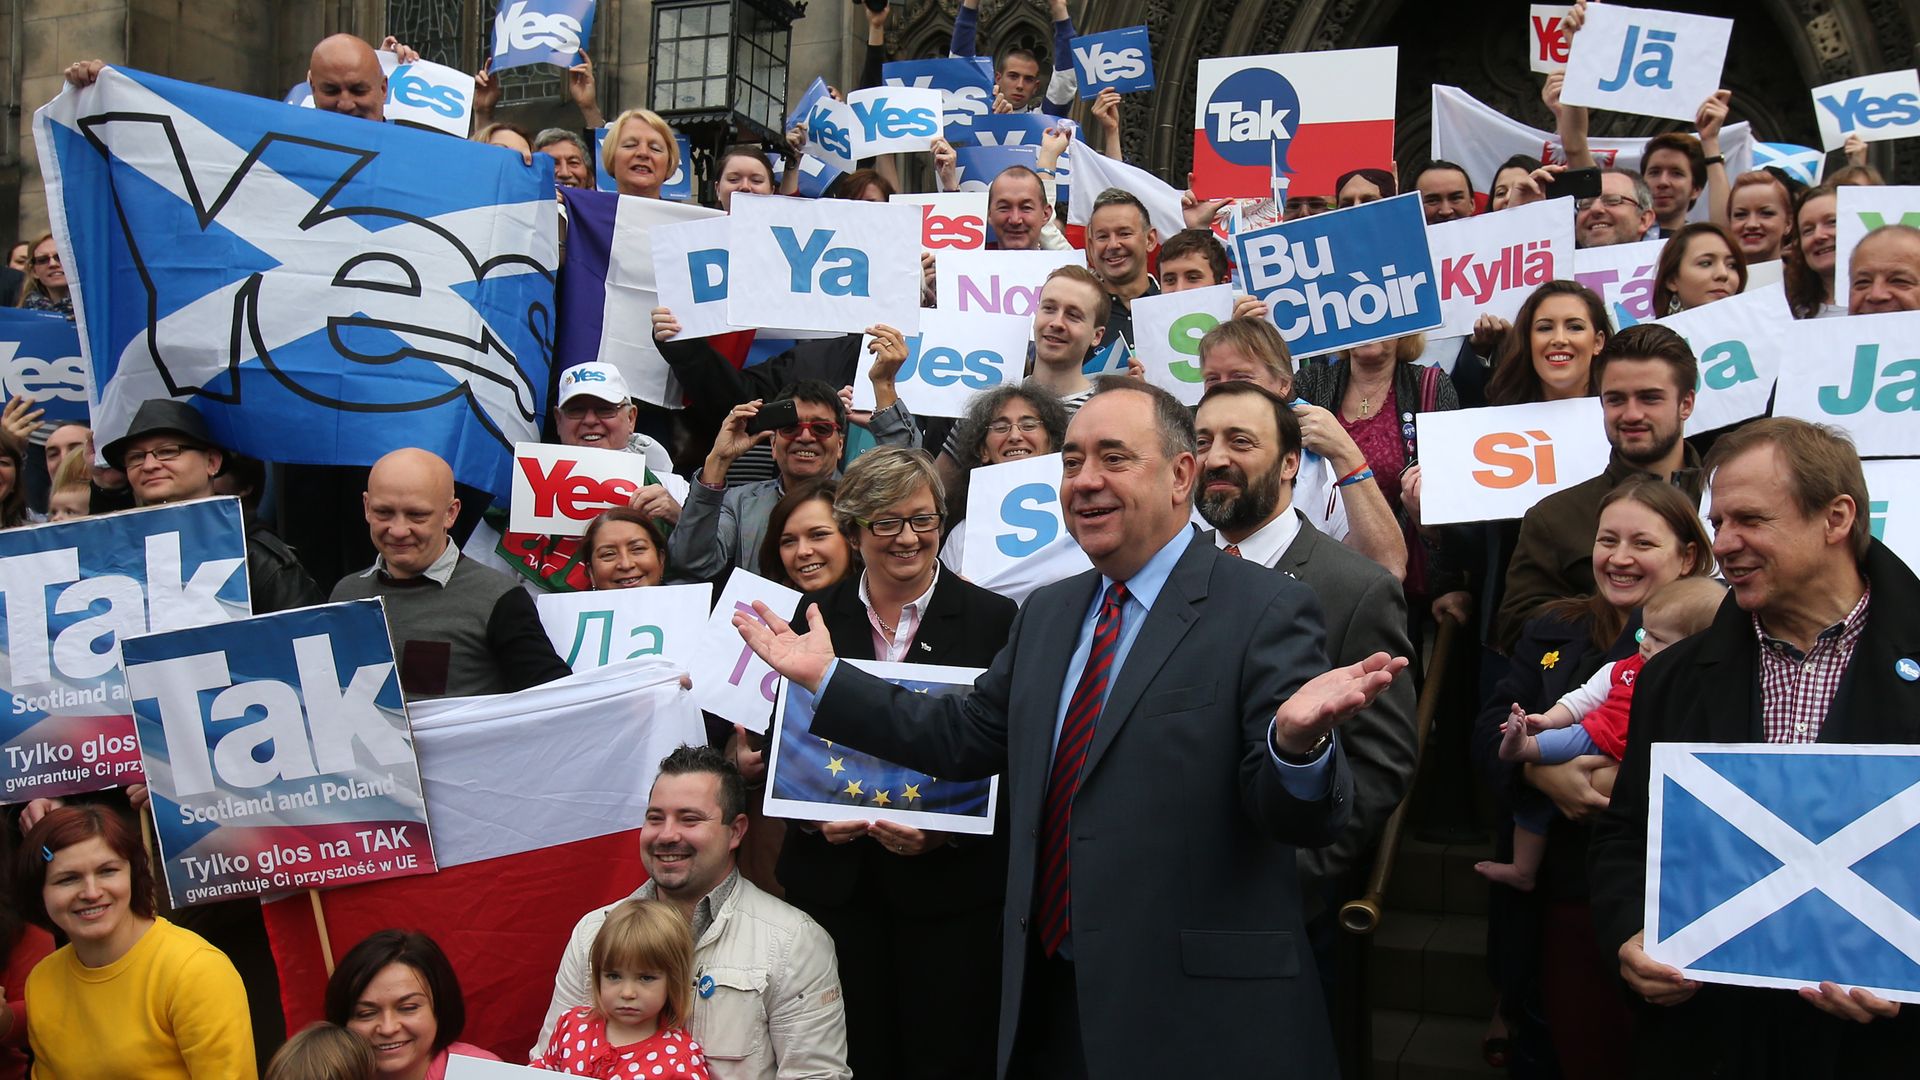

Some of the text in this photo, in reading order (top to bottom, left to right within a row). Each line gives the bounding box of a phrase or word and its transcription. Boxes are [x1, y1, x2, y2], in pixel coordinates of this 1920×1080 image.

[494, 1, 582, 55] Yes
[1073, 42, 1146, 85] Yes
[1598, 25, 1677, 92] Jā
[850, 97, 938, 142] Yes
[1208, 99, 1292, 142] Tak
[1817, 88, 1920, 133] Yes
[770, 225, 869, 297] Ya
[1243, 233, 1335, 291] Bu
[1441, 239, 1555, 305] Kyllä
[1262, 264, 1428, 342] Chòir
[571, 368, 607, 383] Yes
[1817, 343, 1920, 416] Ja
[1472, 430, 1557, 489] Sì
[517, 456, 639, 521] Yes
[0, 531, 246, 687] Tak
[1899, 660, 1920, 678] Yes
[12, 681, 106, 715] Scotland
[125, 633, 414, 798] Tak
[5, 733, 137, 773] Tylko glos
[5, 765, 91, 793] gwarantuje
[95, 761, 111, 776] Ci
[180, 773, 397, 825] Scotland and Poland
[180, 826, 412, 884] Tylko glos na TAK
[186, 876, 271, 903] gwarantuje
[273, 872, 291, 887] Ci
[379, 861, 392, 872] w
[396, 854, 418, 871] UE
